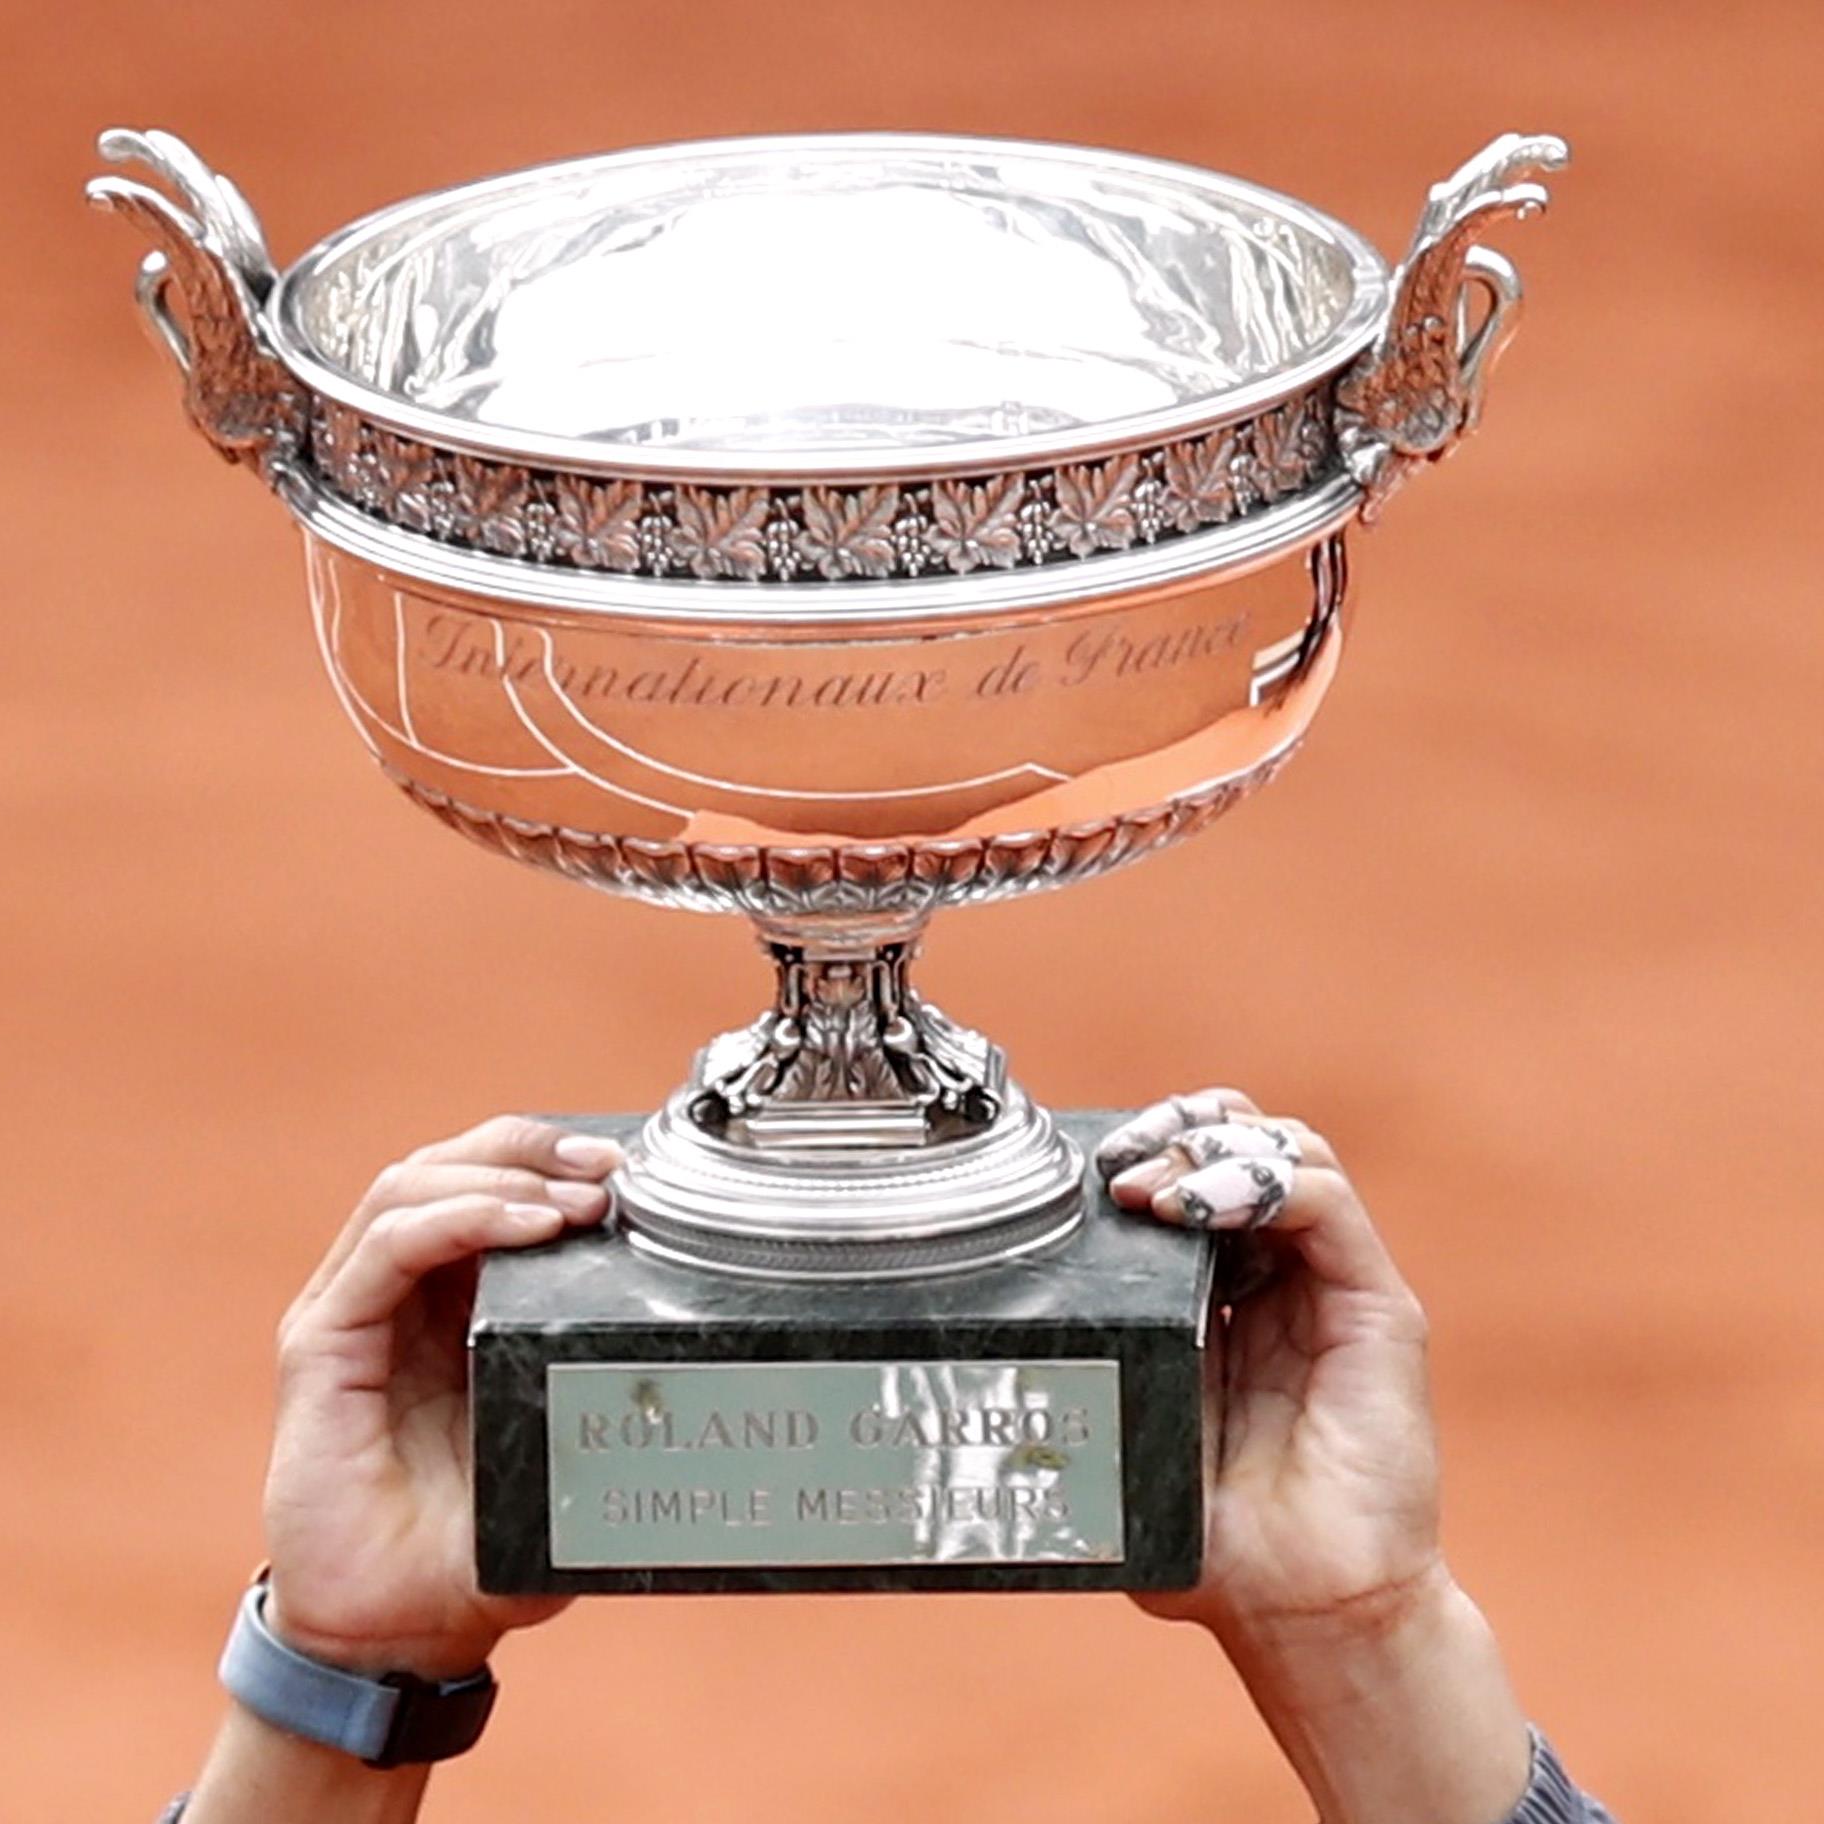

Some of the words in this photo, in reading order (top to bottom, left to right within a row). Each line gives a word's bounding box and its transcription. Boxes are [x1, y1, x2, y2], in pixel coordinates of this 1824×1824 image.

[419, 613, 946, 707] Internationaux
[977, 645, 1041, 697] de
[1061, 611, 1252, 686] France
[577, 1409, 820, 1450] ROLAND
[849, 1407, 1092, 1448] GARROS
[602, 1488, 772, 1527] SIMPLE
[796, 1486, 1070, 1525] MESSIEURS
